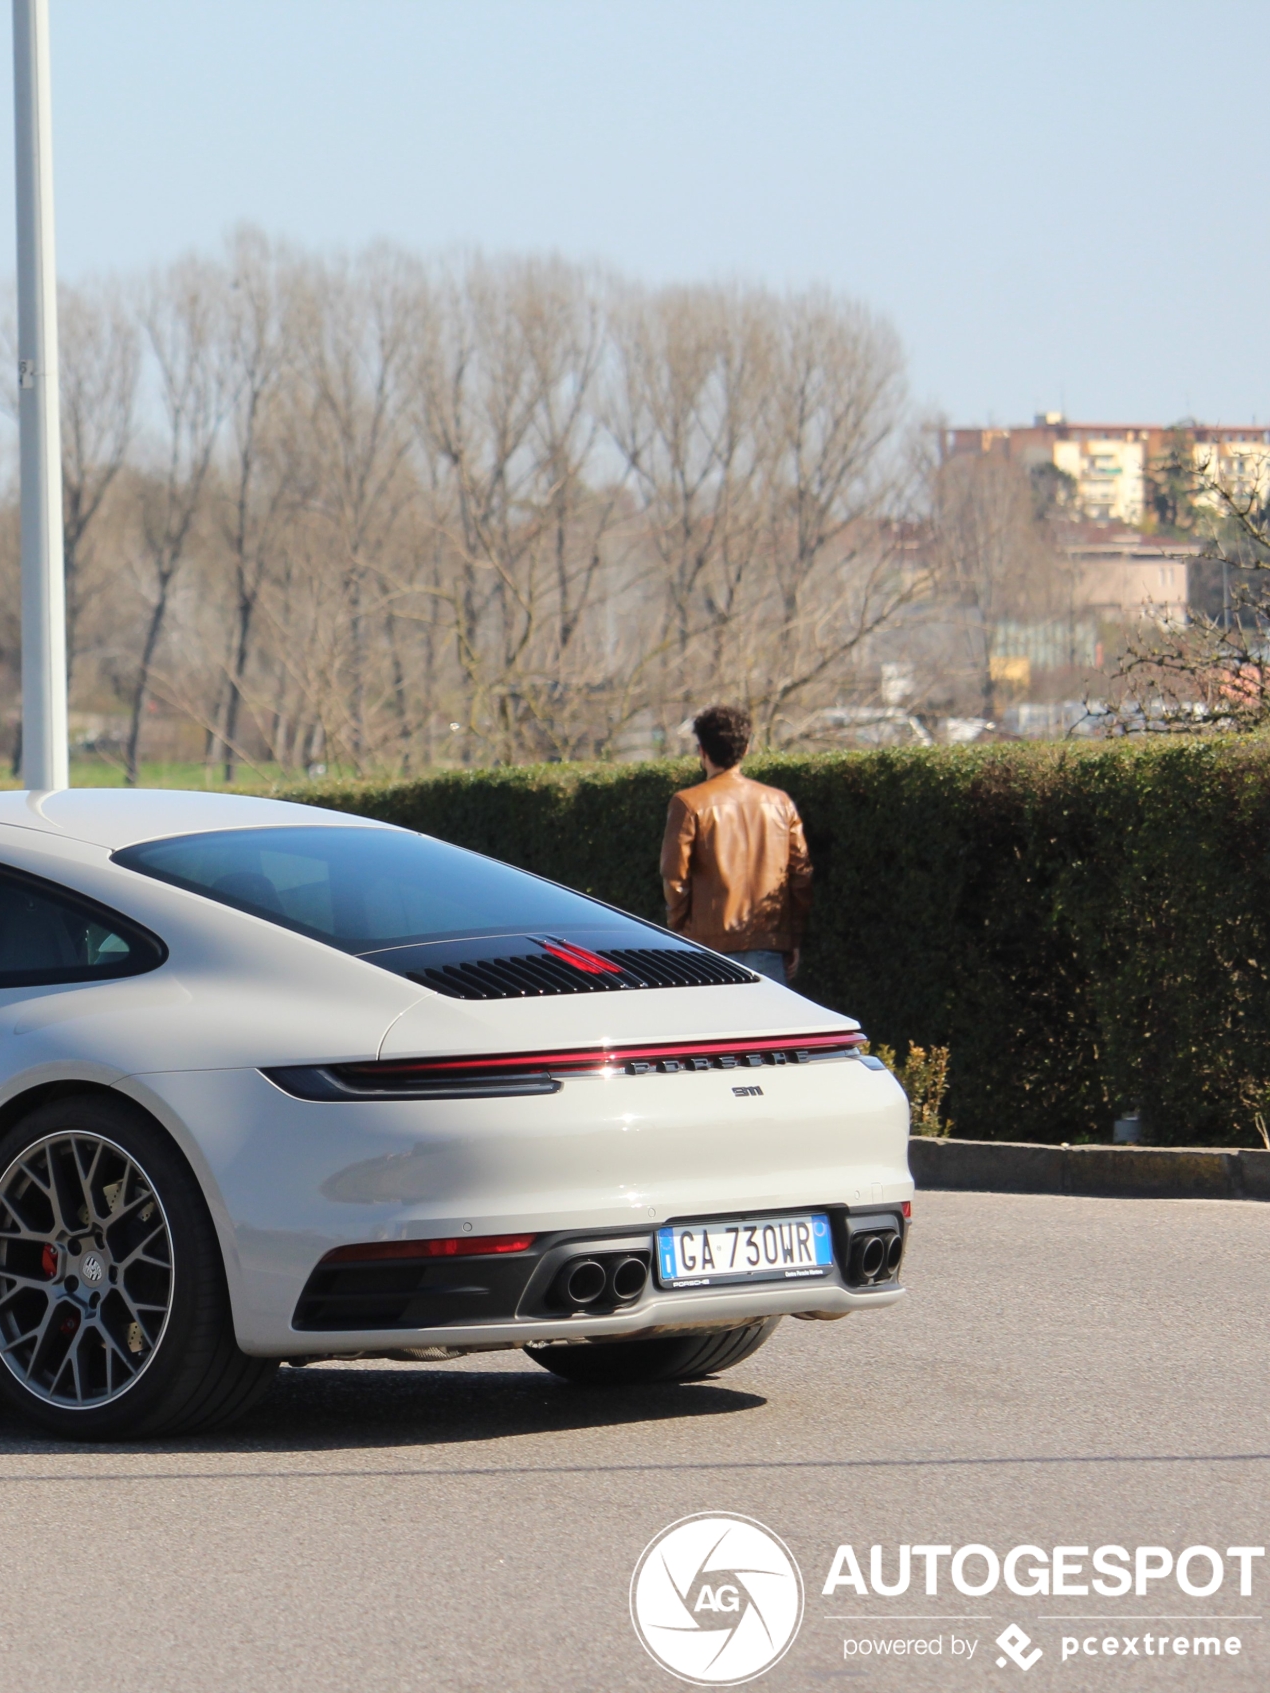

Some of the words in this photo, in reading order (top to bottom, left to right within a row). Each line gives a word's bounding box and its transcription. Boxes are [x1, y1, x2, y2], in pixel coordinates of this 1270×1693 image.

[625, 1051, 810, 1076] PORSCHE
[731, 1085, 765, 1097] 911
[679, 1229, 716, 1271] GA
[725, 1221, 813, 1268] 730WR
[672, 1279, 710, 1288] PORSCHE
